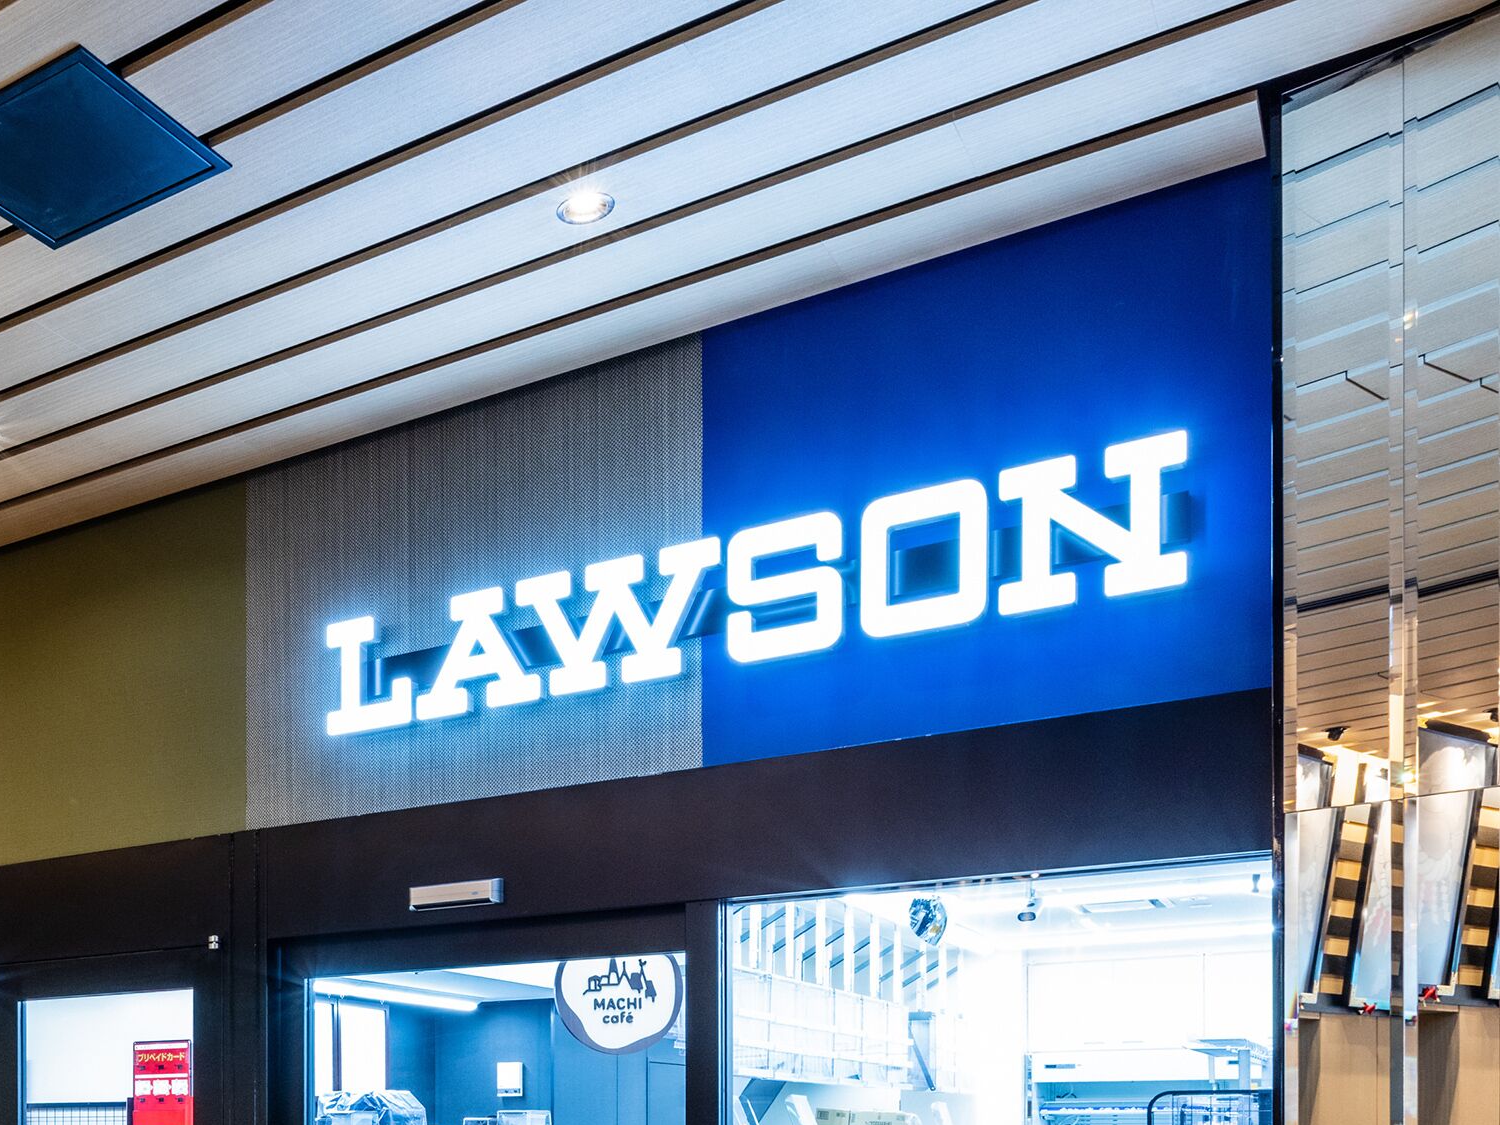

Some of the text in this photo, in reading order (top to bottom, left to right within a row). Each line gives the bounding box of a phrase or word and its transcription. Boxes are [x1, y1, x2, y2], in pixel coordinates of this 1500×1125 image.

[326, 429, 1188, 736] LAWSON
[593, 997, 642, 1010] MACHI
[602, 1012, 634, 1024] café
